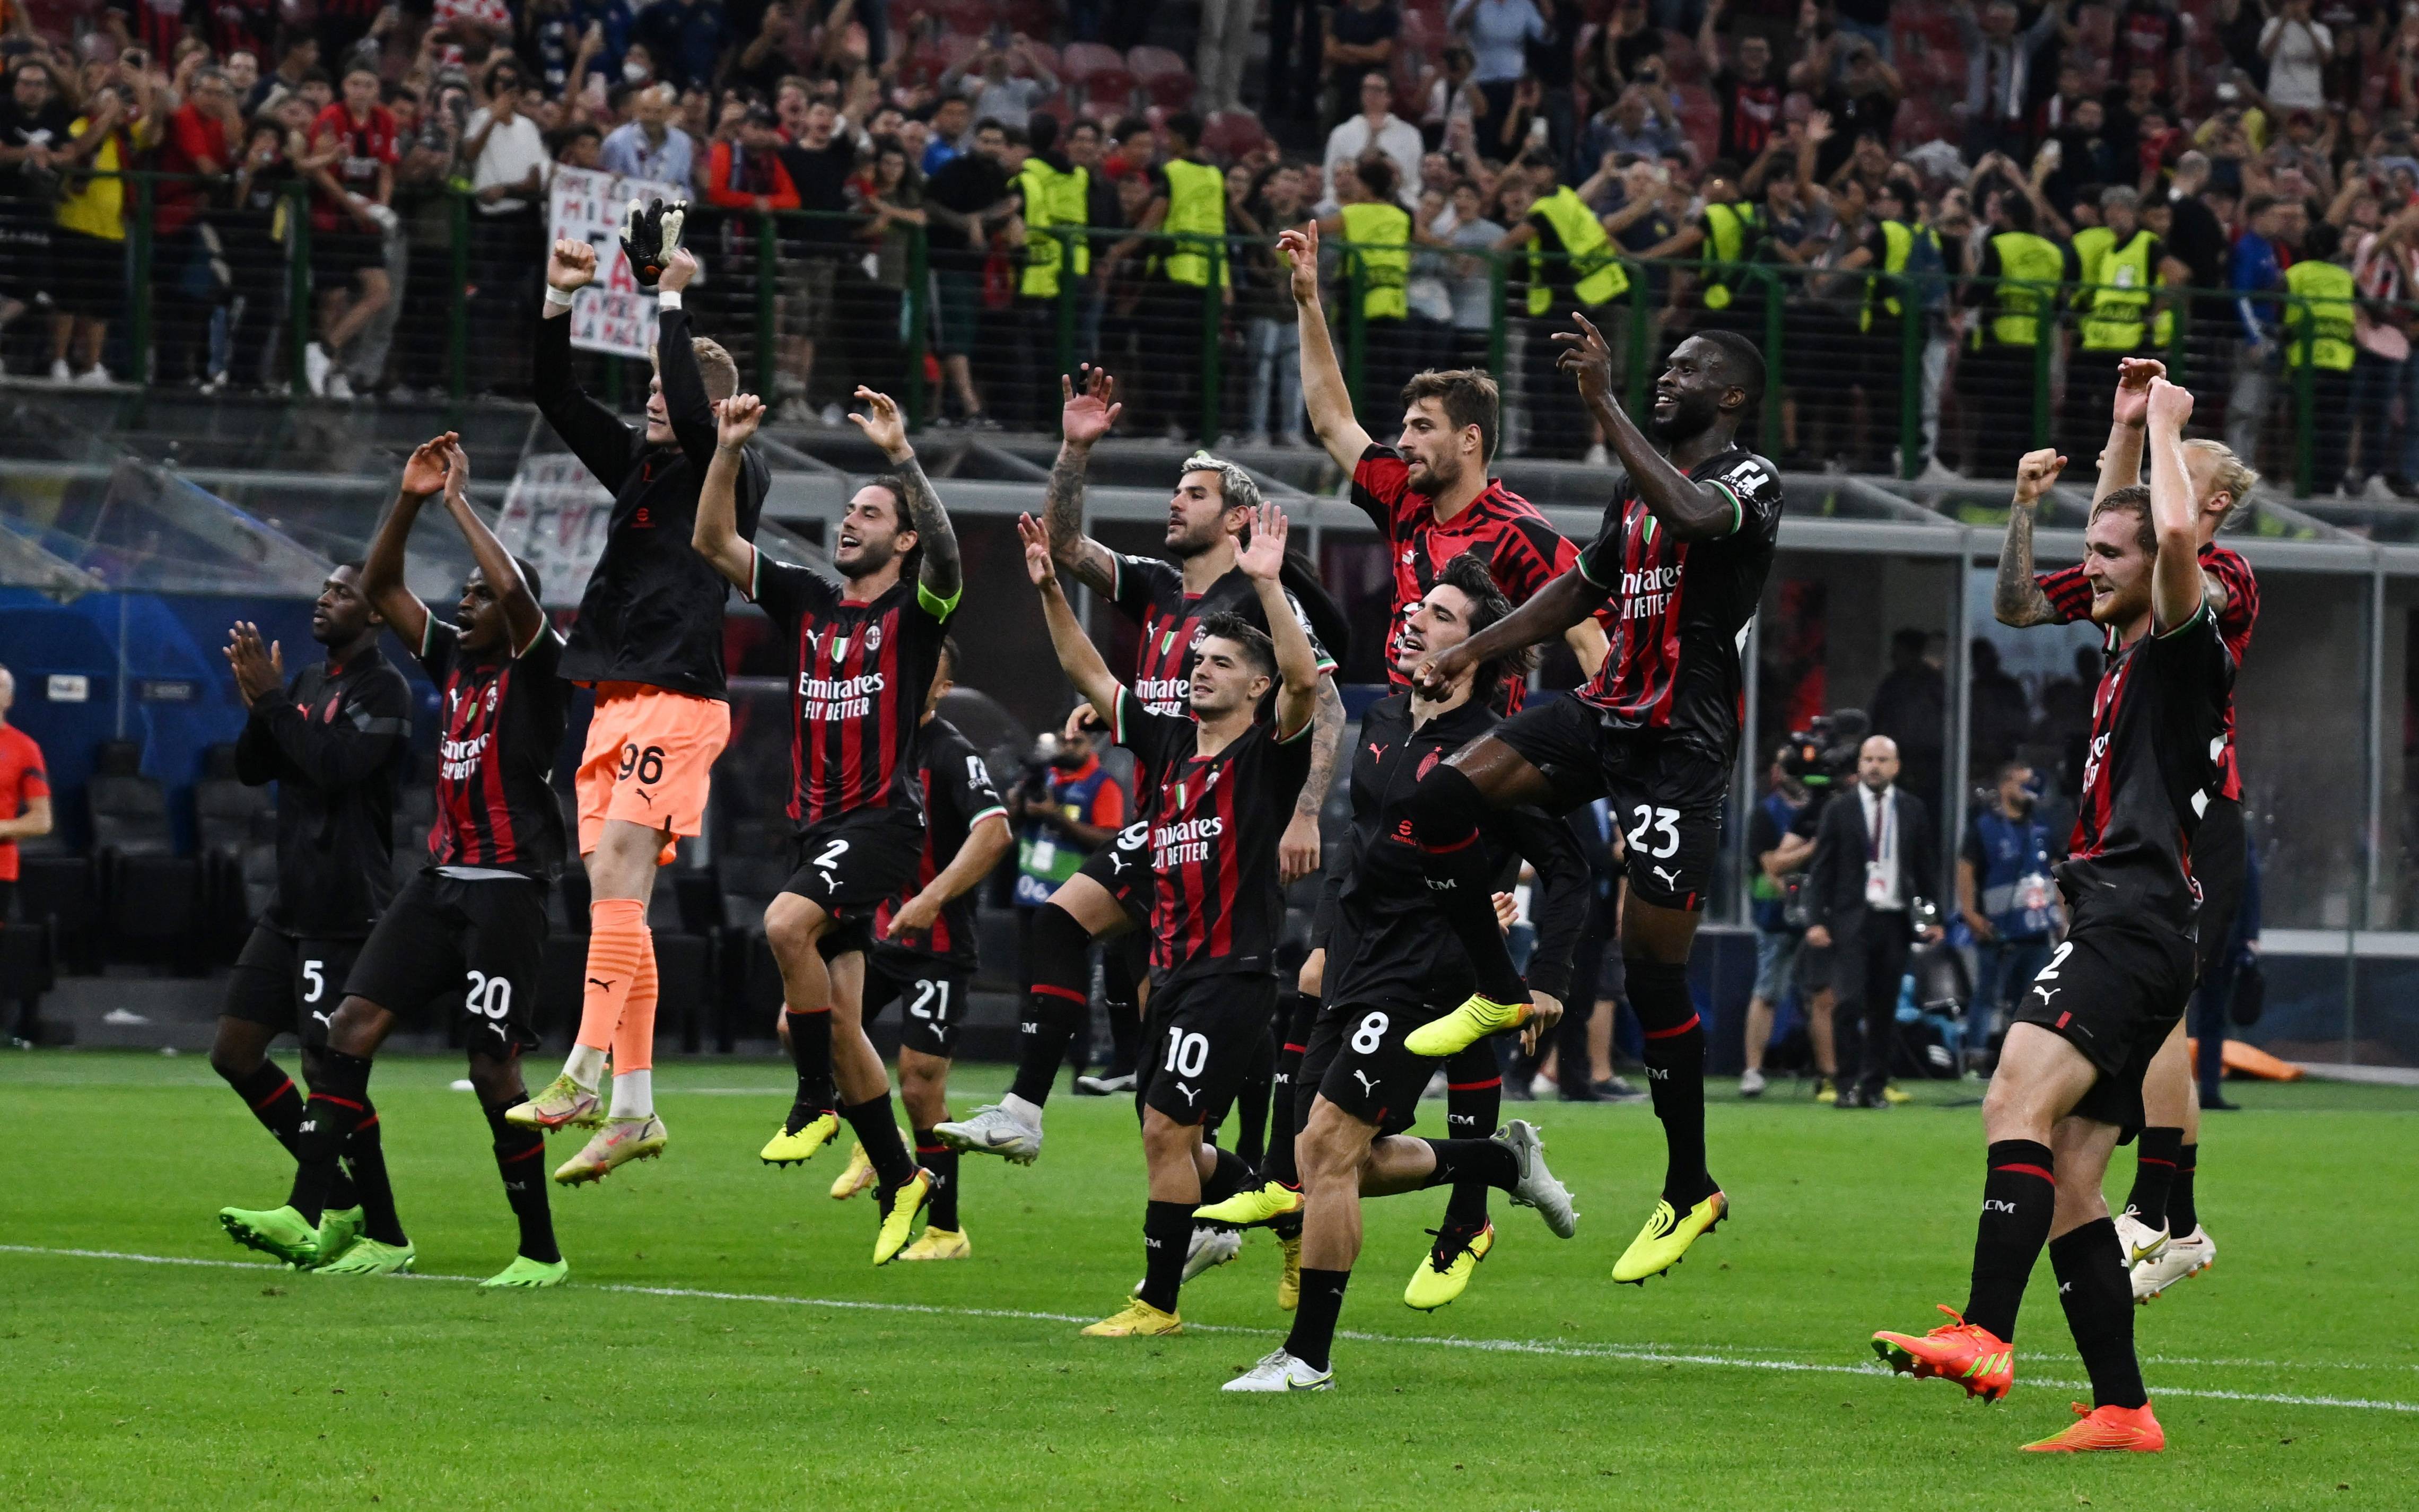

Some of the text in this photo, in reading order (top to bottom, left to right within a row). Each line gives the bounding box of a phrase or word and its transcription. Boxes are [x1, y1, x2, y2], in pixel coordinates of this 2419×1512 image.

[798, 671, 885, 700] Emirates
[1135, 672, 1190, 699] mirate
[805, 697, 870, 721] FLY BETTER
[619, 744, 665, 784] 96
[1391, 833, 1417, 846] FOOTBALL
[1627, 804, 1680, 858] 23
[813, 839, 849, 869] 2
[1167, 841, 1209, 866] BETTER
[303, 960, 324, 1003] 5
[466, 970, 511, 1019] 20
[910, 979, 949, 1020] 21
[1351, 1011, 1389, 1054] 8
[1164, 1026, 1209, 1078] 10
[1644, 1065, 1669, 1080] CM
[1447, 1114, 1475, 1125] CM
[1982, 1199, 2016, 1213] CM
